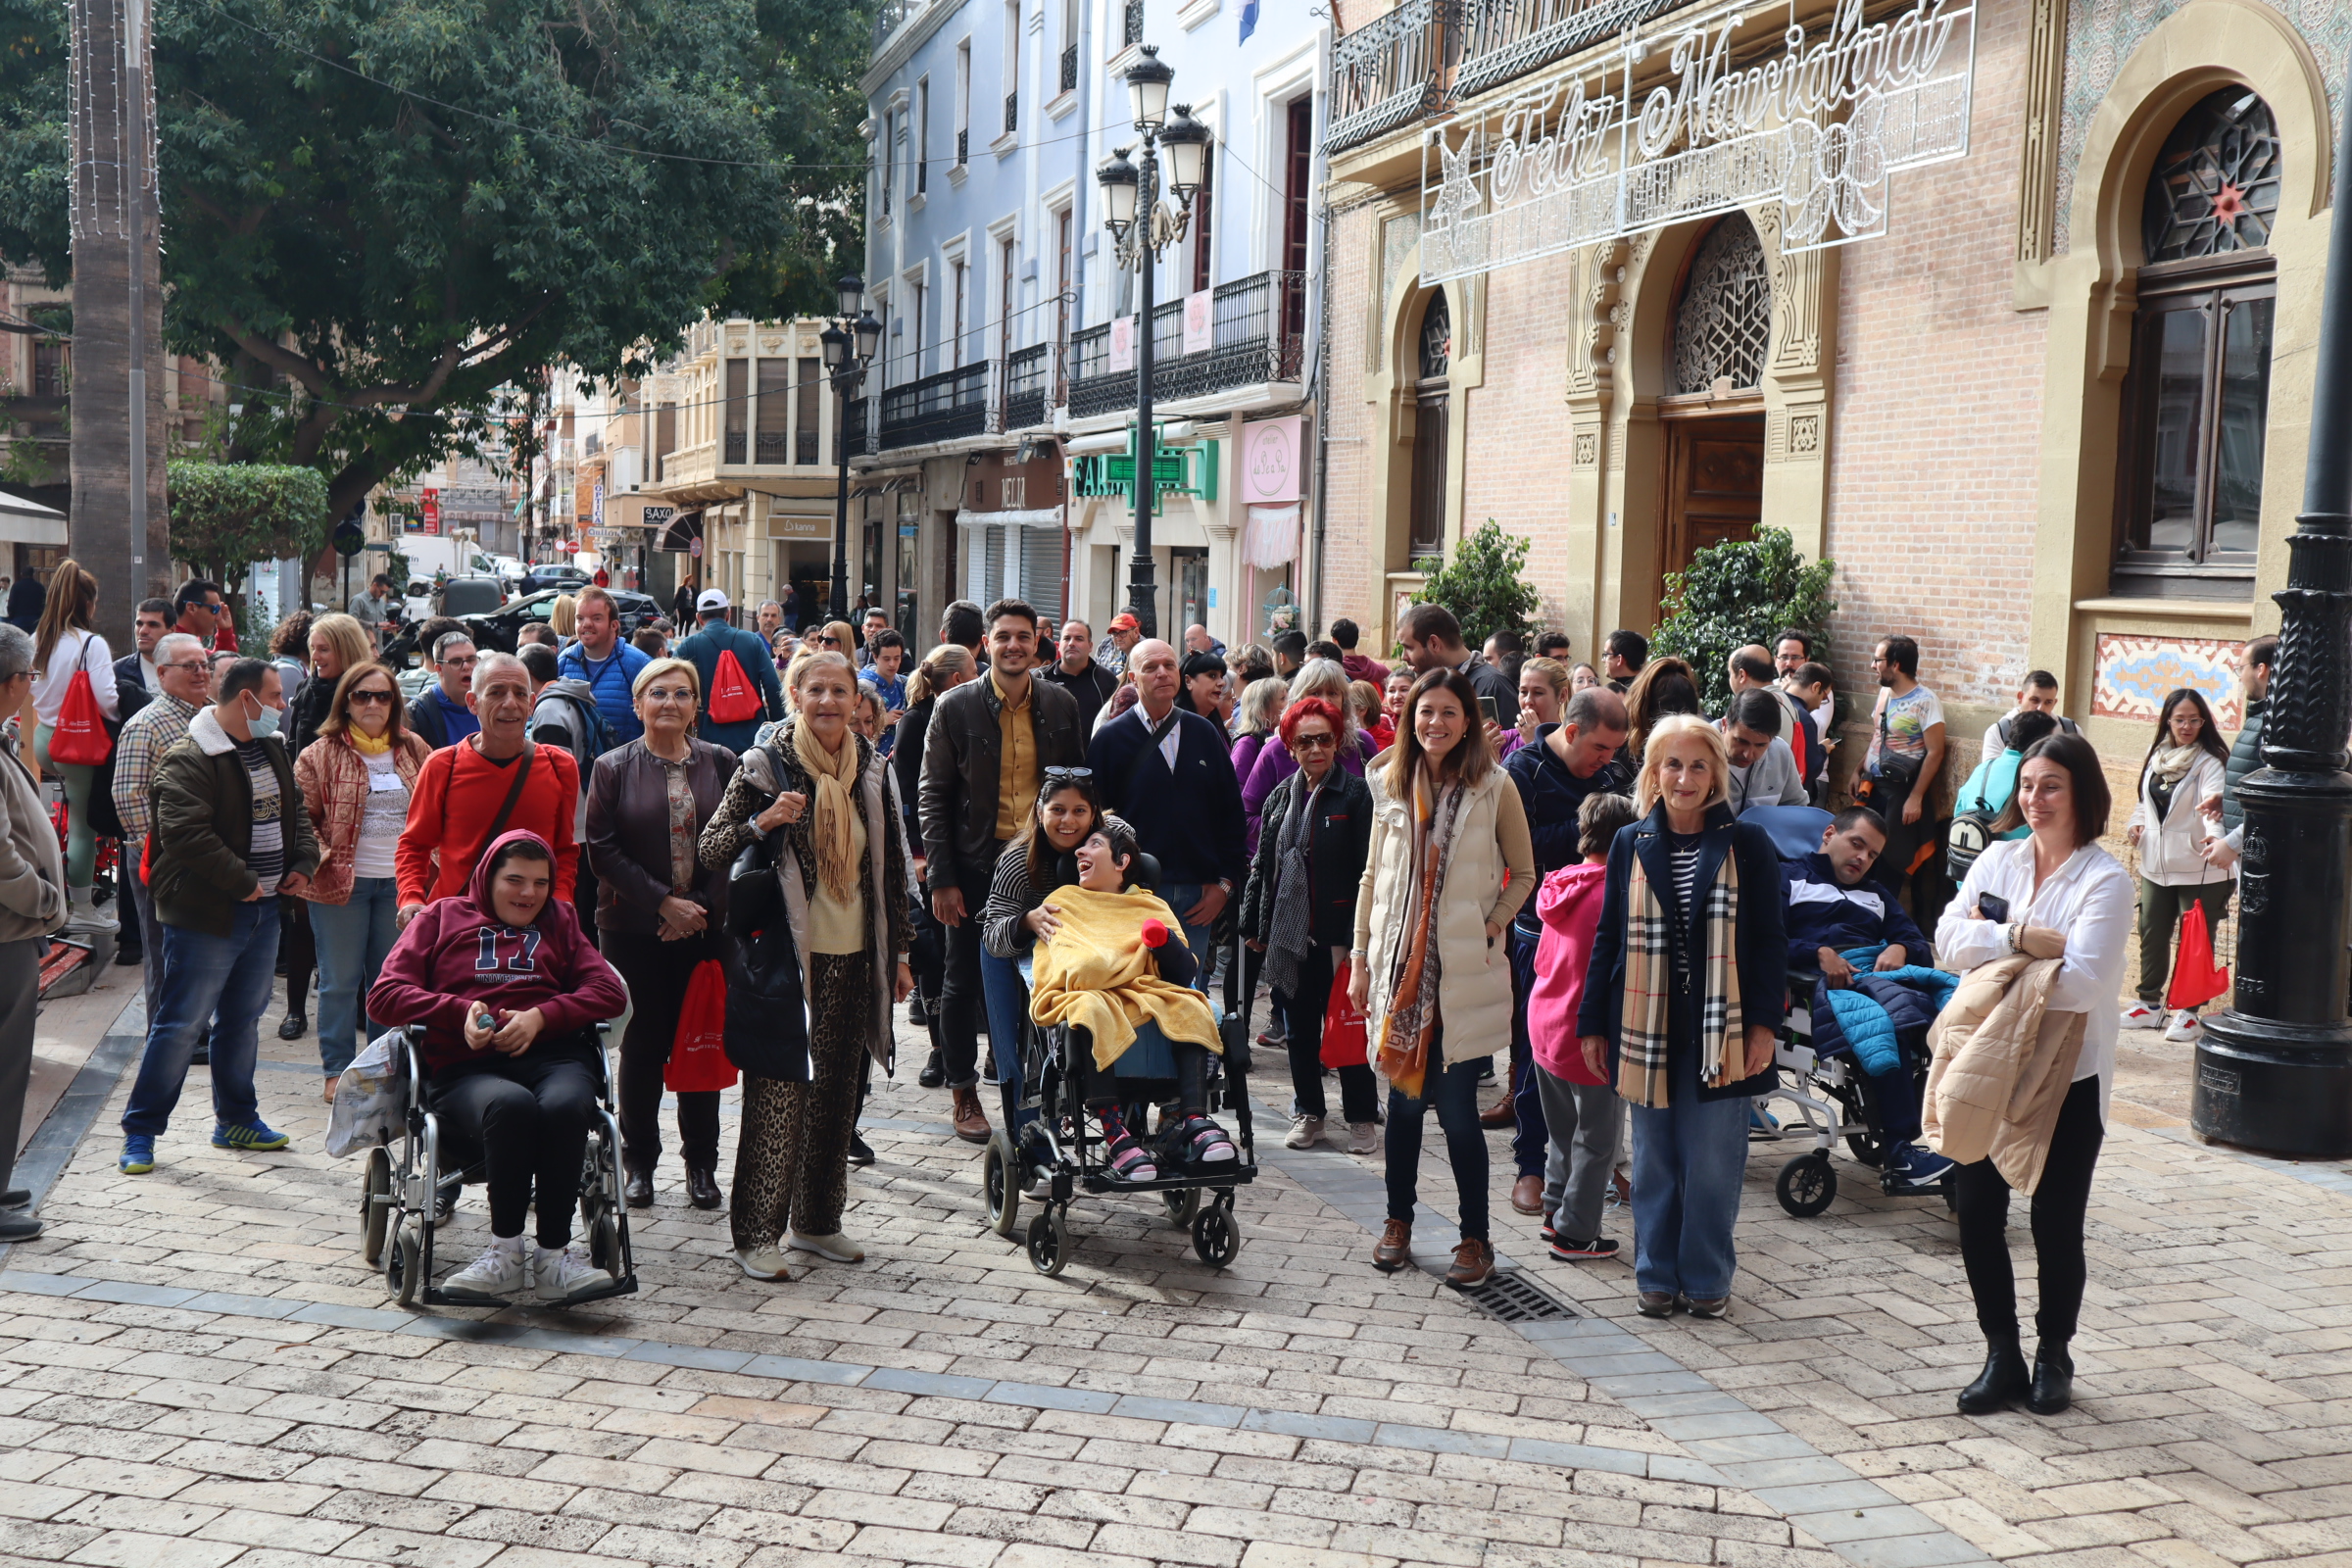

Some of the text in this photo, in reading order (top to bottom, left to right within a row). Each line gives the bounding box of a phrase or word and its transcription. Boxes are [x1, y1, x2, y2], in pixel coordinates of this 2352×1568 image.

[1491, 0, 1954, 205] Feliz Navidad
[645, 508, 671, 519] SAXO
[795, 522, 815, 532] kanna
[475, 926, 541, 971] 17
